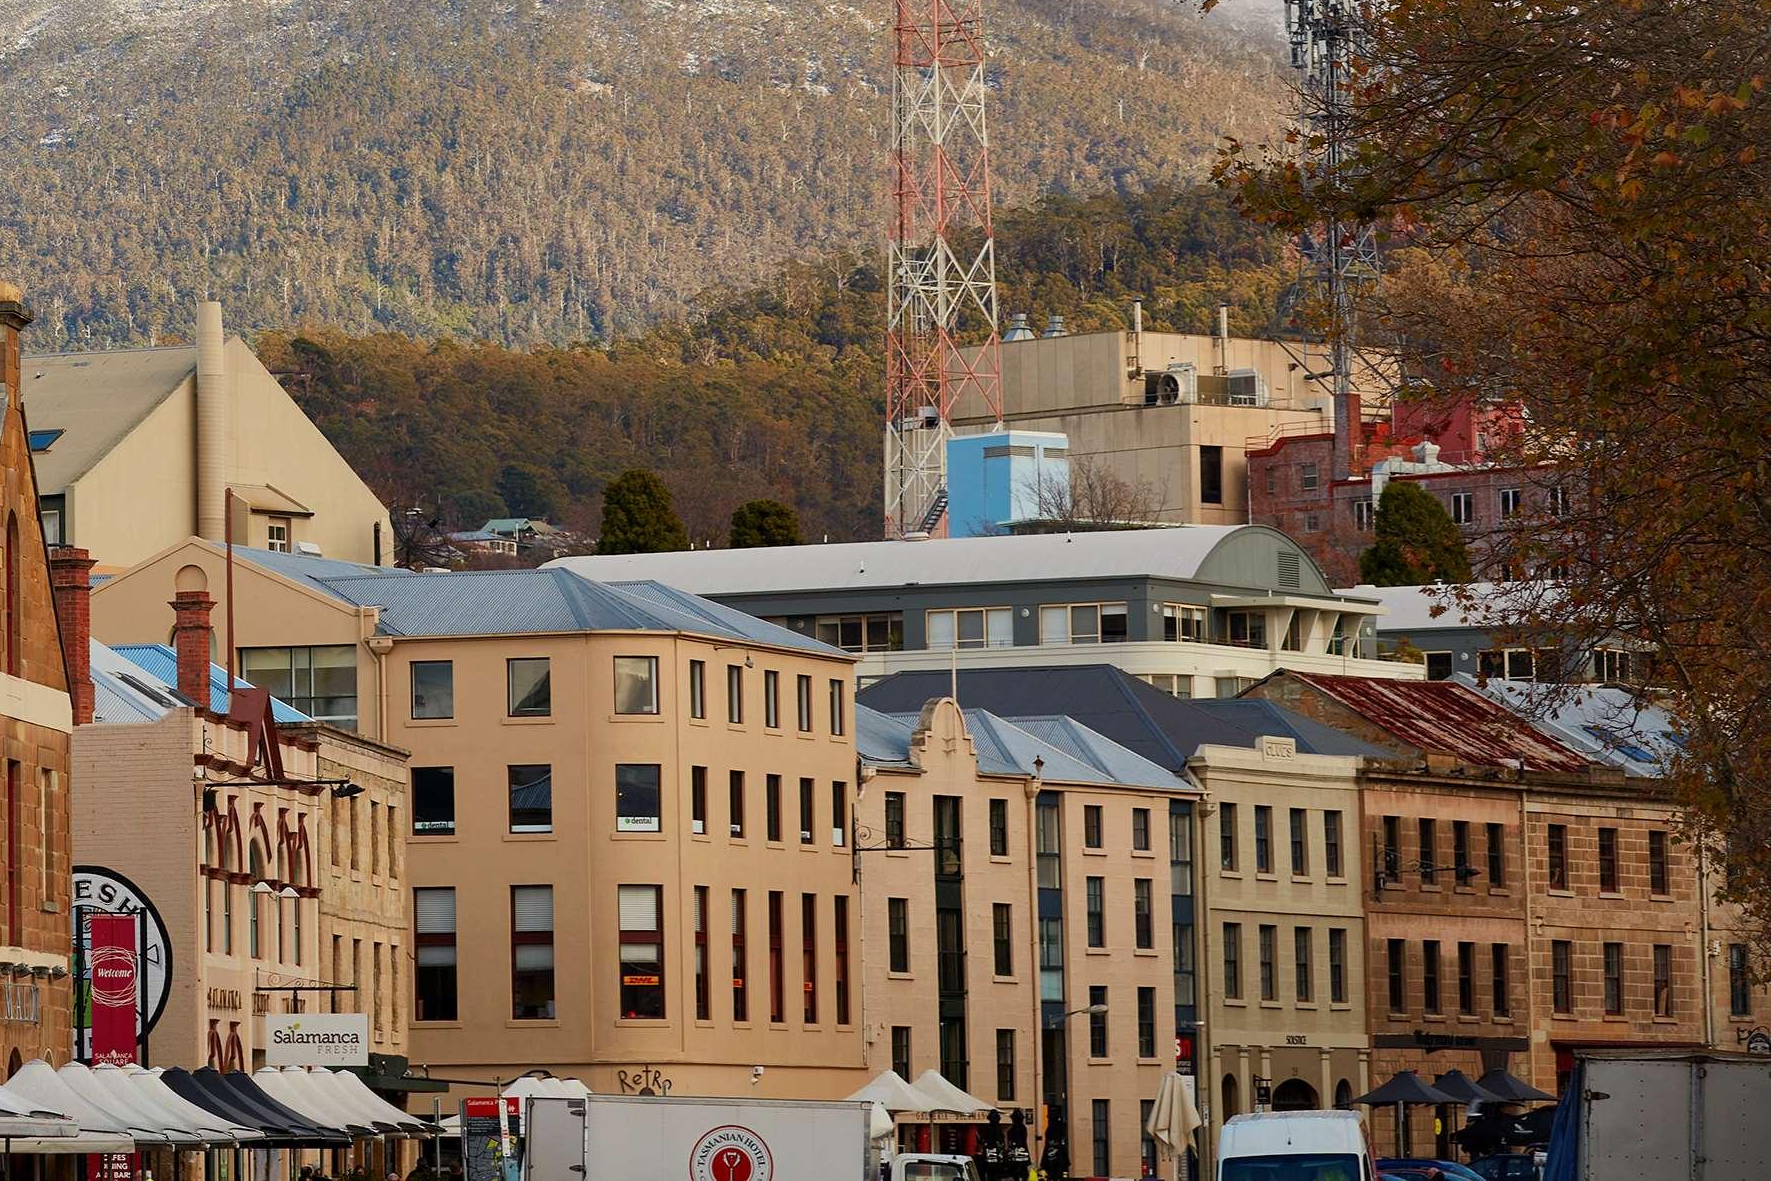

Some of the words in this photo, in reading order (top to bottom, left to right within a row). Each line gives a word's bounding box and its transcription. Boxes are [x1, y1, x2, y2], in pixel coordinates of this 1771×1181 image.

[97, 967, 133, 979] Welcome
[274, 1030, 360, 1044] Salamanca
[317, 1045, 358, 1055] FRESH
[697, 1133, 745, 1168] TASMANIAN
